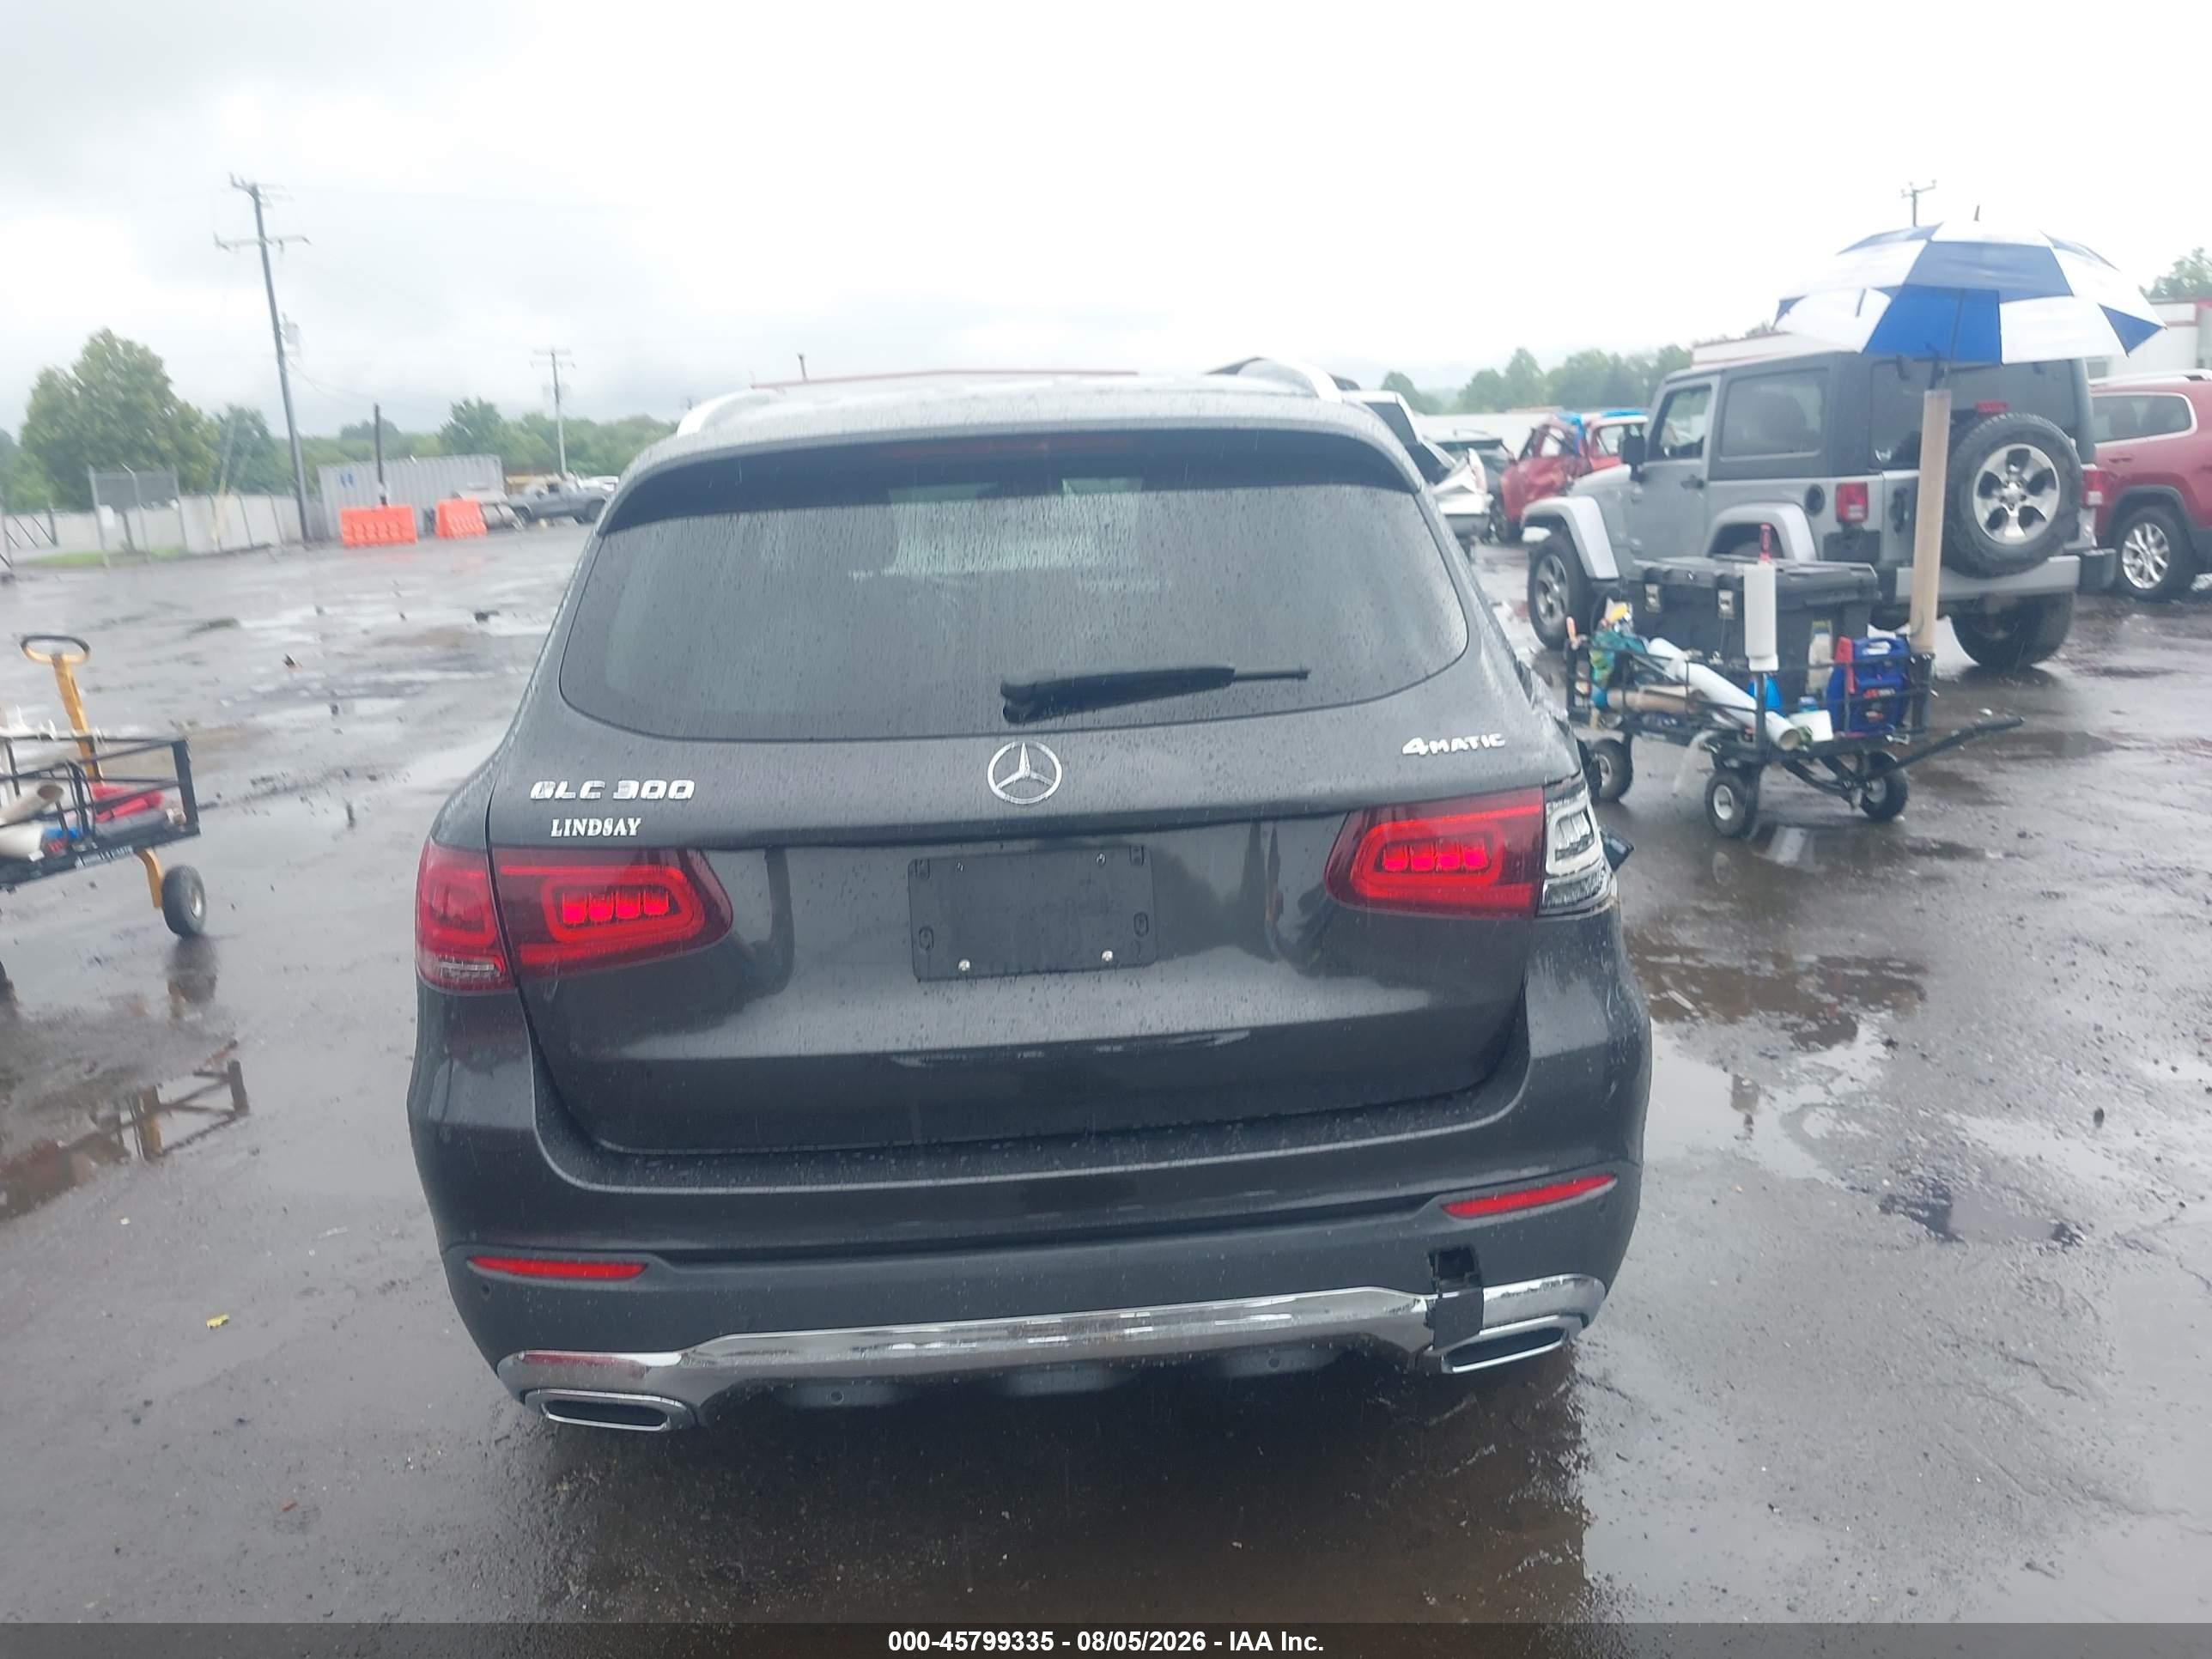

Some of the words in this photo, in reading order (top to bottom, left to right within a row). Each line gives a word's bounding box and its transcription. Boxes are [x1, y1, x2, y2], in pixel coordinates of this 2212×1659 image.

[1401, 732, 1506, 756] 4MATIC
[530, 780, 606, 800] GLC
[612, 780, 696, 800] 300
[550, 817, 642, 838] LINDSAY
